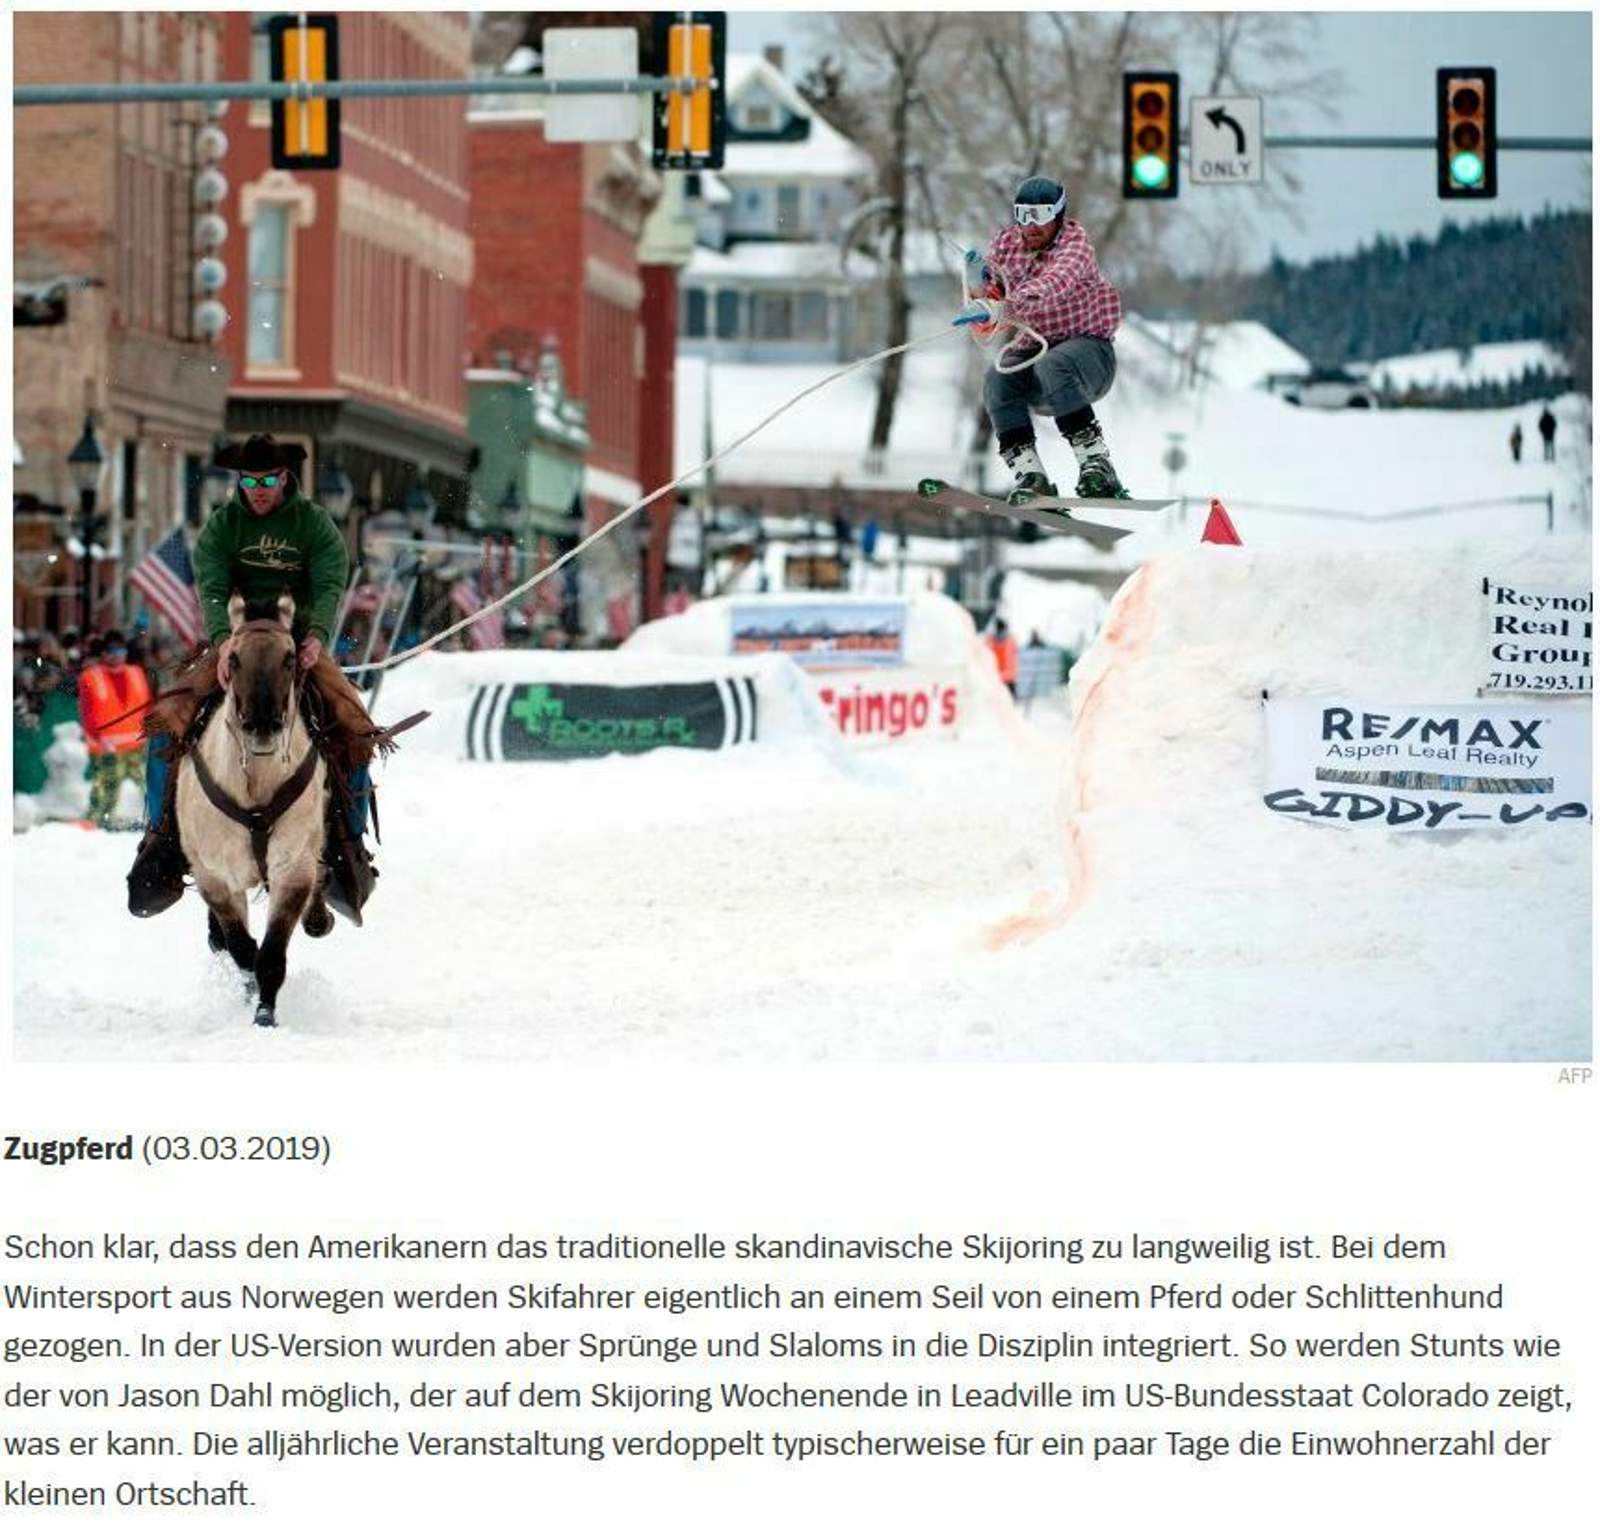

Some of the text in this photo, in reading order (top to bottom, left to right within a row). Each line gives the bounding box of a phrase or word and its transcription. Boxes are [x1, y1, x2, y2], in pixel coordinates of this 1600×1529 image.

[1200, 160, 1252, 178] ONLY
[1493, 615, 1569, 637] Real
[1321, 707, 1543, 749] RE/MAX
[1326, 743, 1540, 769] Aspen Leaf Realty
